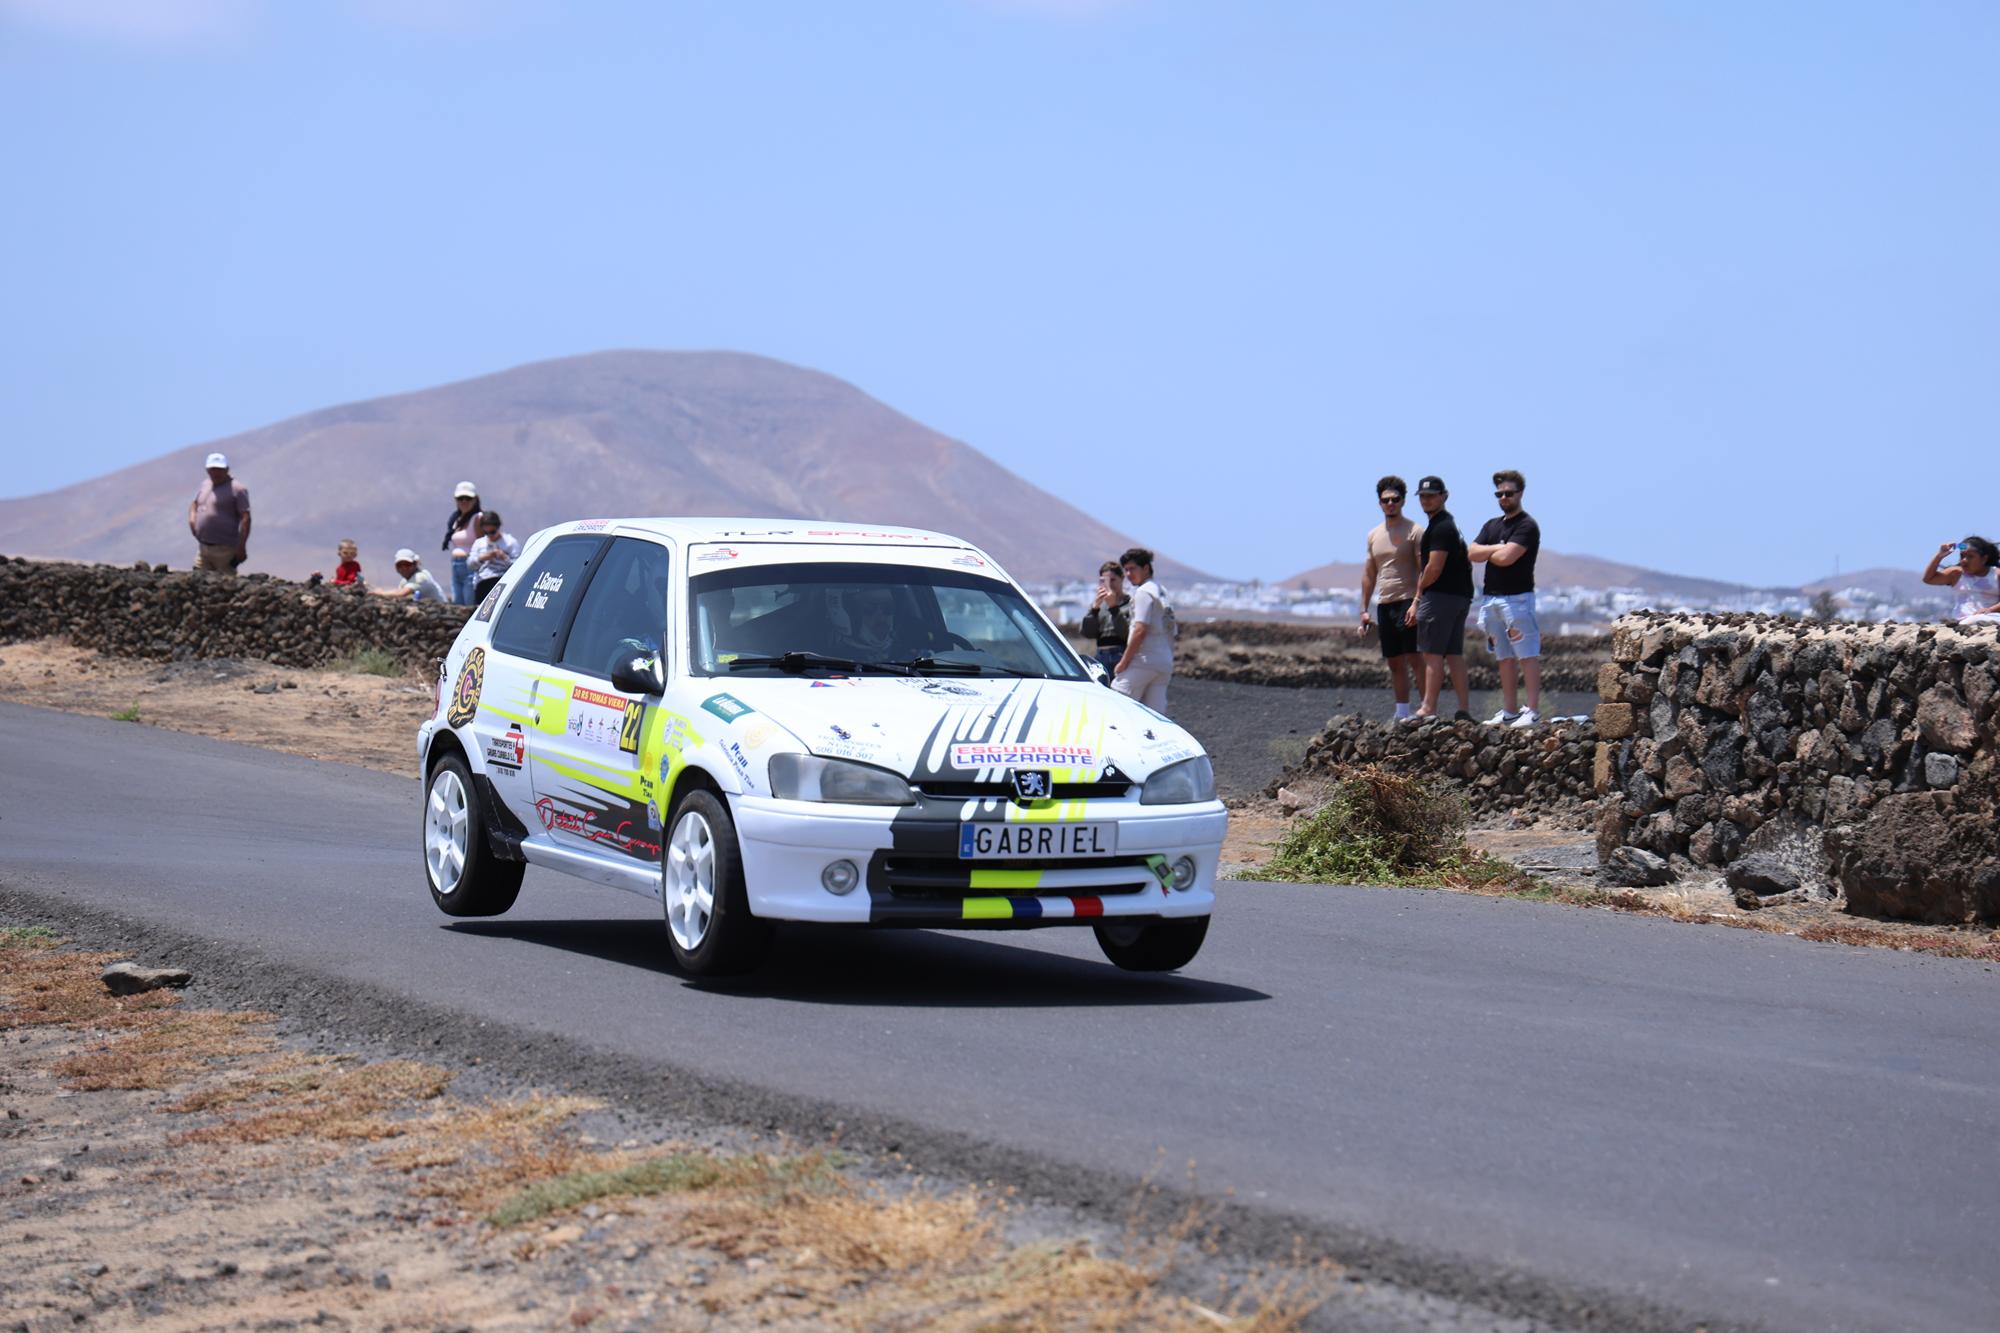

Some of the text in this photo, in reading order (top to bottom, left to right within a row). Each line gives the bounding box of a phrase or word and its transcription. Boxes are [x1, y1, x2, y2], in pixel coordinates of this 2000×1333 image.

[808, 531, 937, 541] SPORT
[608, 696, 625, 709] VIERA
[621, 702, 643, 751] 22
[957, 746, 1091, 755] ESCUDERIA
[957, 753, 1093, 764] LANZAROTE
[976, 826, 1106, 854] GABRIEL
